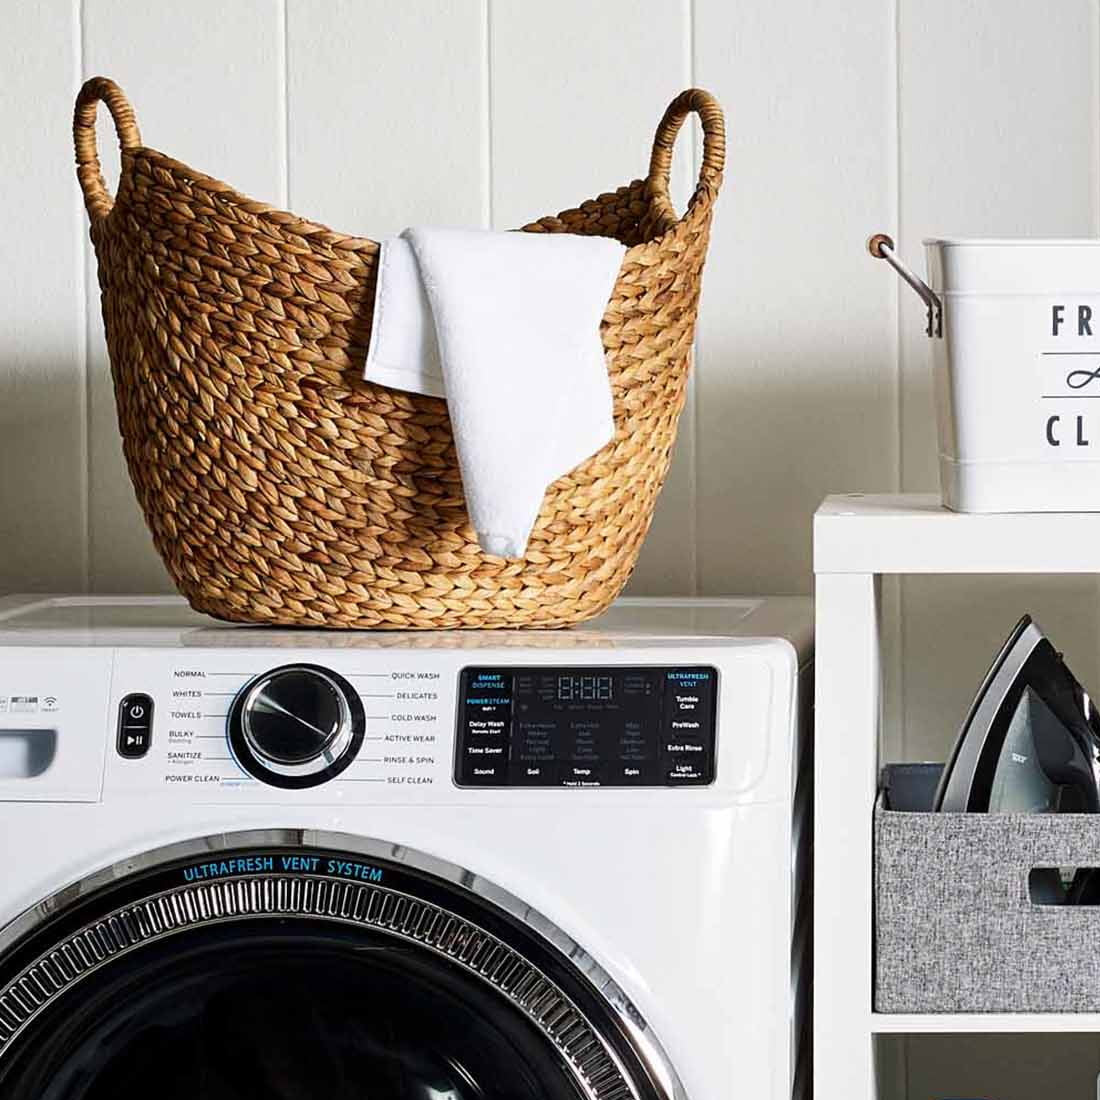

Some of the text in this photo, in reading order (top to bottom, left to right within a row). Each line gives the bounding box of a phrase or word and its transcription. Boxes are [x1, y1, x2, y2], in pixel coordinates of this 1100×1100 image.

[173, 670, 206, 678] NORMAL
[391, 672, 415, 680] QUICK
[172, 690, 202, 698] WHITES
[396, 692, 438, 700] DELICATES
[676, 695, 699, 703] Tumble
[171, 711, 202, 719] TOWELS
[168, 730, 194, 738] BULKY
[573, 768, 591, 776] Temp
[624, 768, 640, 776] Spin
[676, 765, 692, 773] Light
[183, 857, 384, 882] ULTRAFRESH VENT SYSTEM
